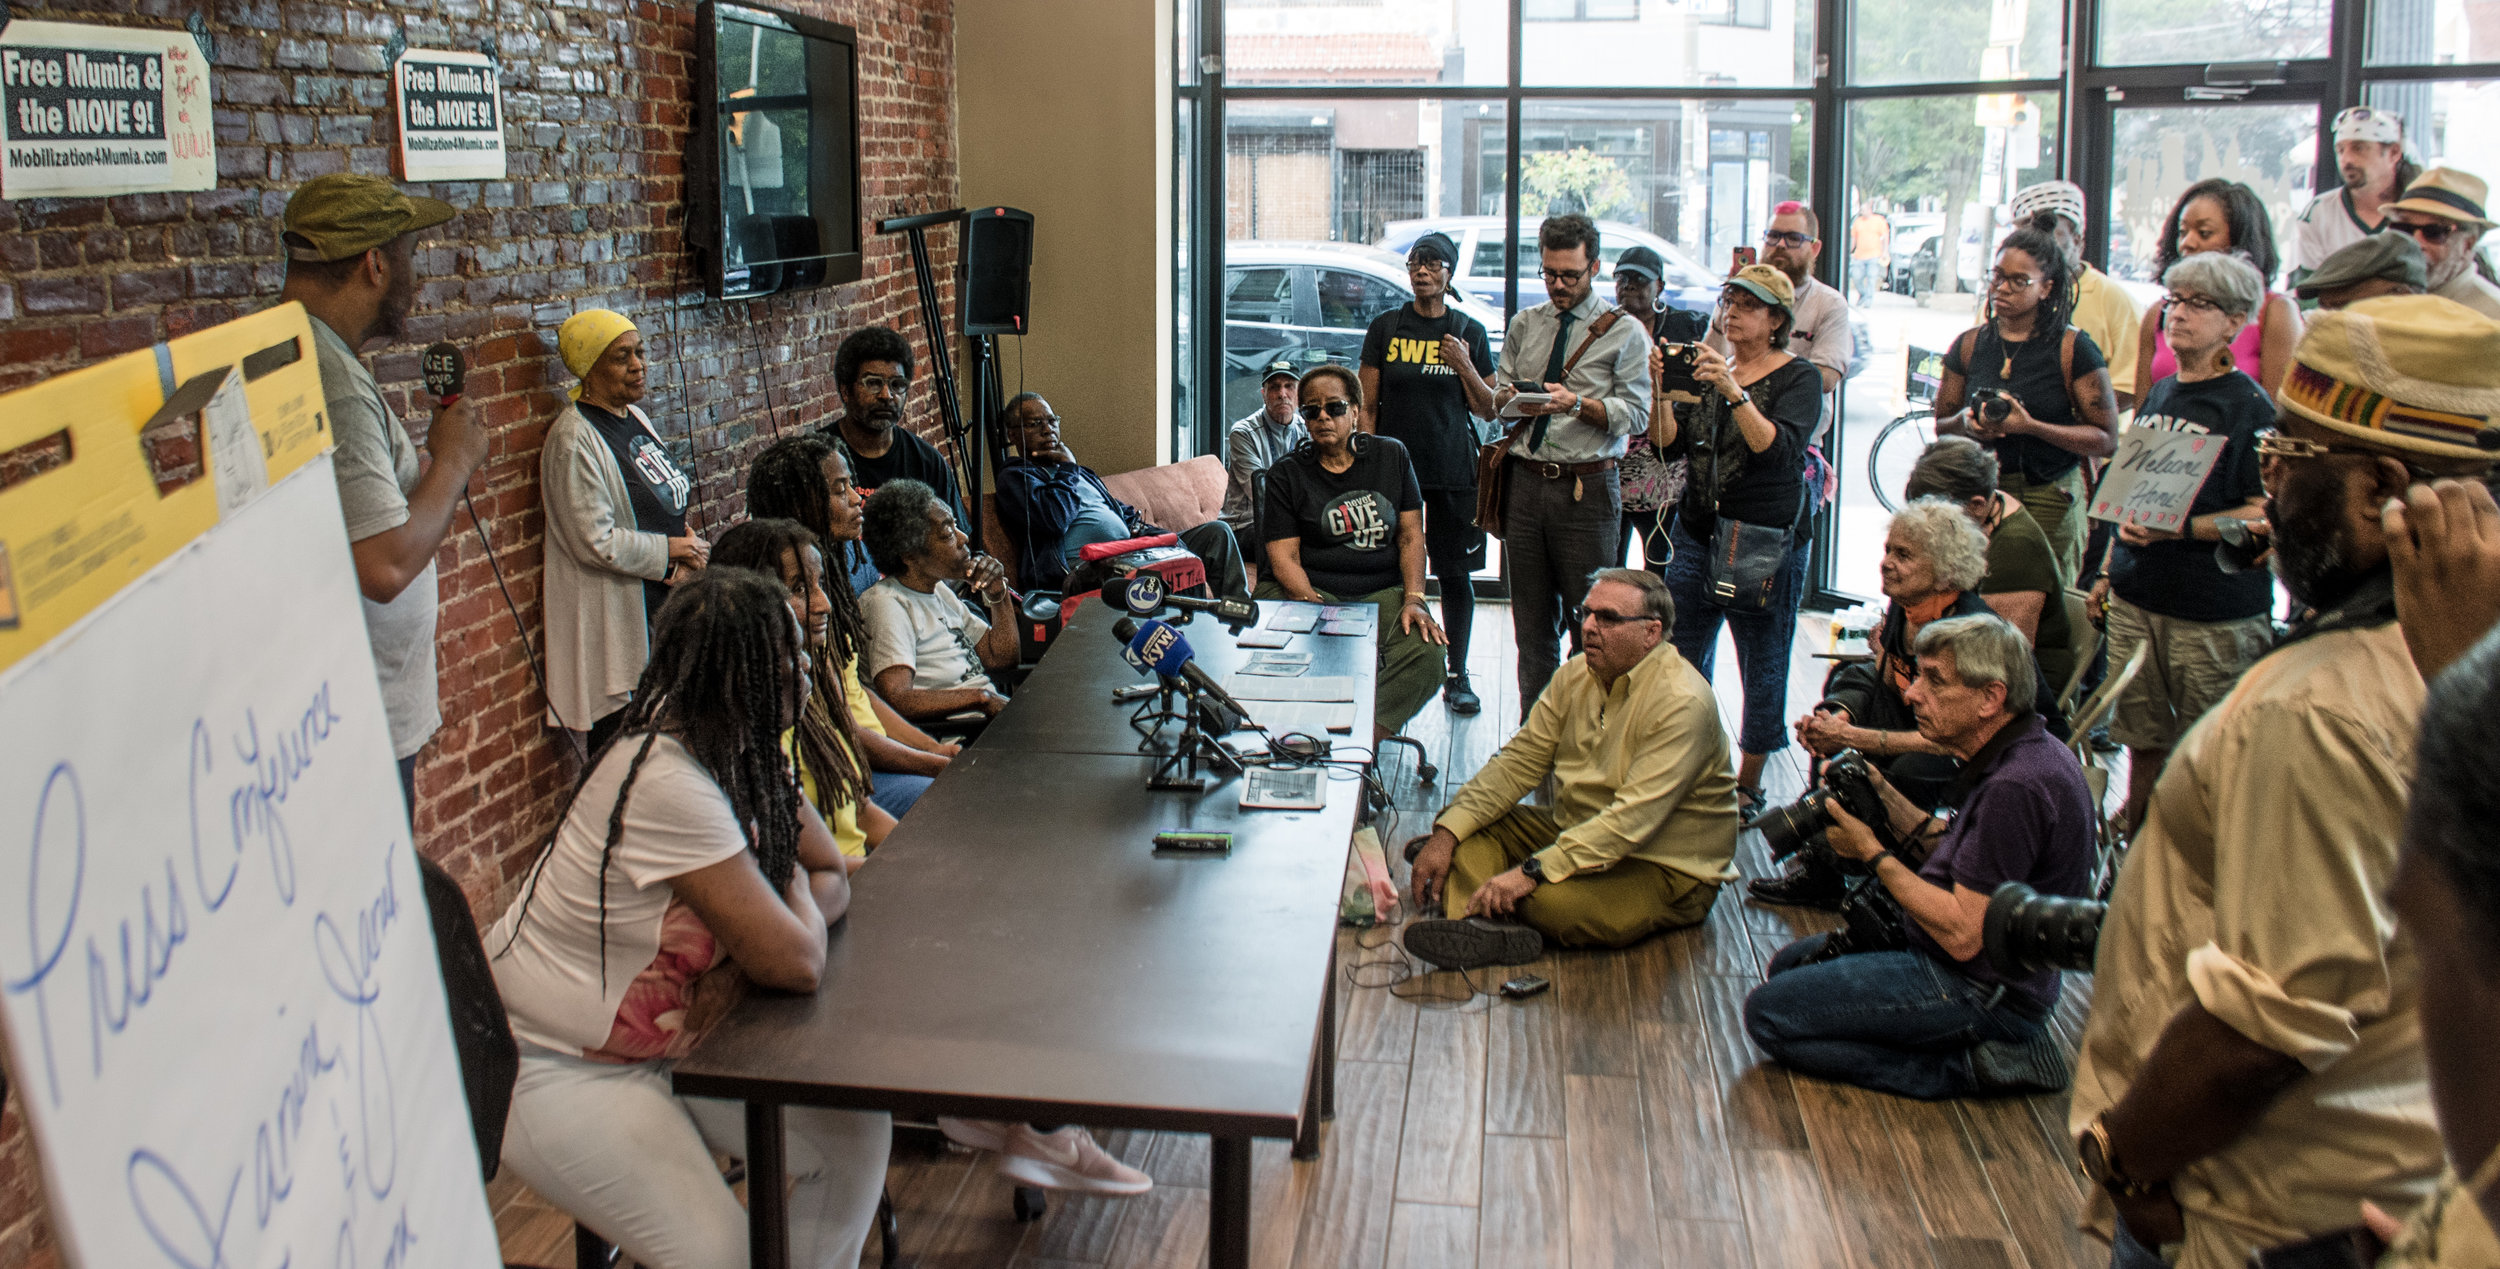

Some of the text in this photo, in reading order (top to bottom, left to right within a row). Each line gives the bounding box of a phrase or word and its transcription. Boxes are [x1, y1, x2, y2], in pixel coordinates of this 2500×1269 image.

[2, 50, 63, 88] Free
[66, 52, 140, 90] Mumia
[144, 57, 162, 91] &
[404, 63, 494, 95] Free Mumia &
[18, 98, 63, 135] the
[66, 98, 131, 134] MOVE
[133, 100, 156, 134] 9!
[410, 98, 492, 128] the MOVE 9!
[10, 147, 168, 168] Mobilization4Mumia.com
[407, 135, 499, 151] Mobilization4Mumia.com
[636, 449, 681, 485] GIVE
[666, 475, 691, 510] UP
[1344, 493, 1372, 508] never
[1328, 500, 1384, 536] GIVE
[1353, 527, 1385, 549] UP
[1142, 629, 1174, 667] kyw
[3, 758, 189, 1112] Press
